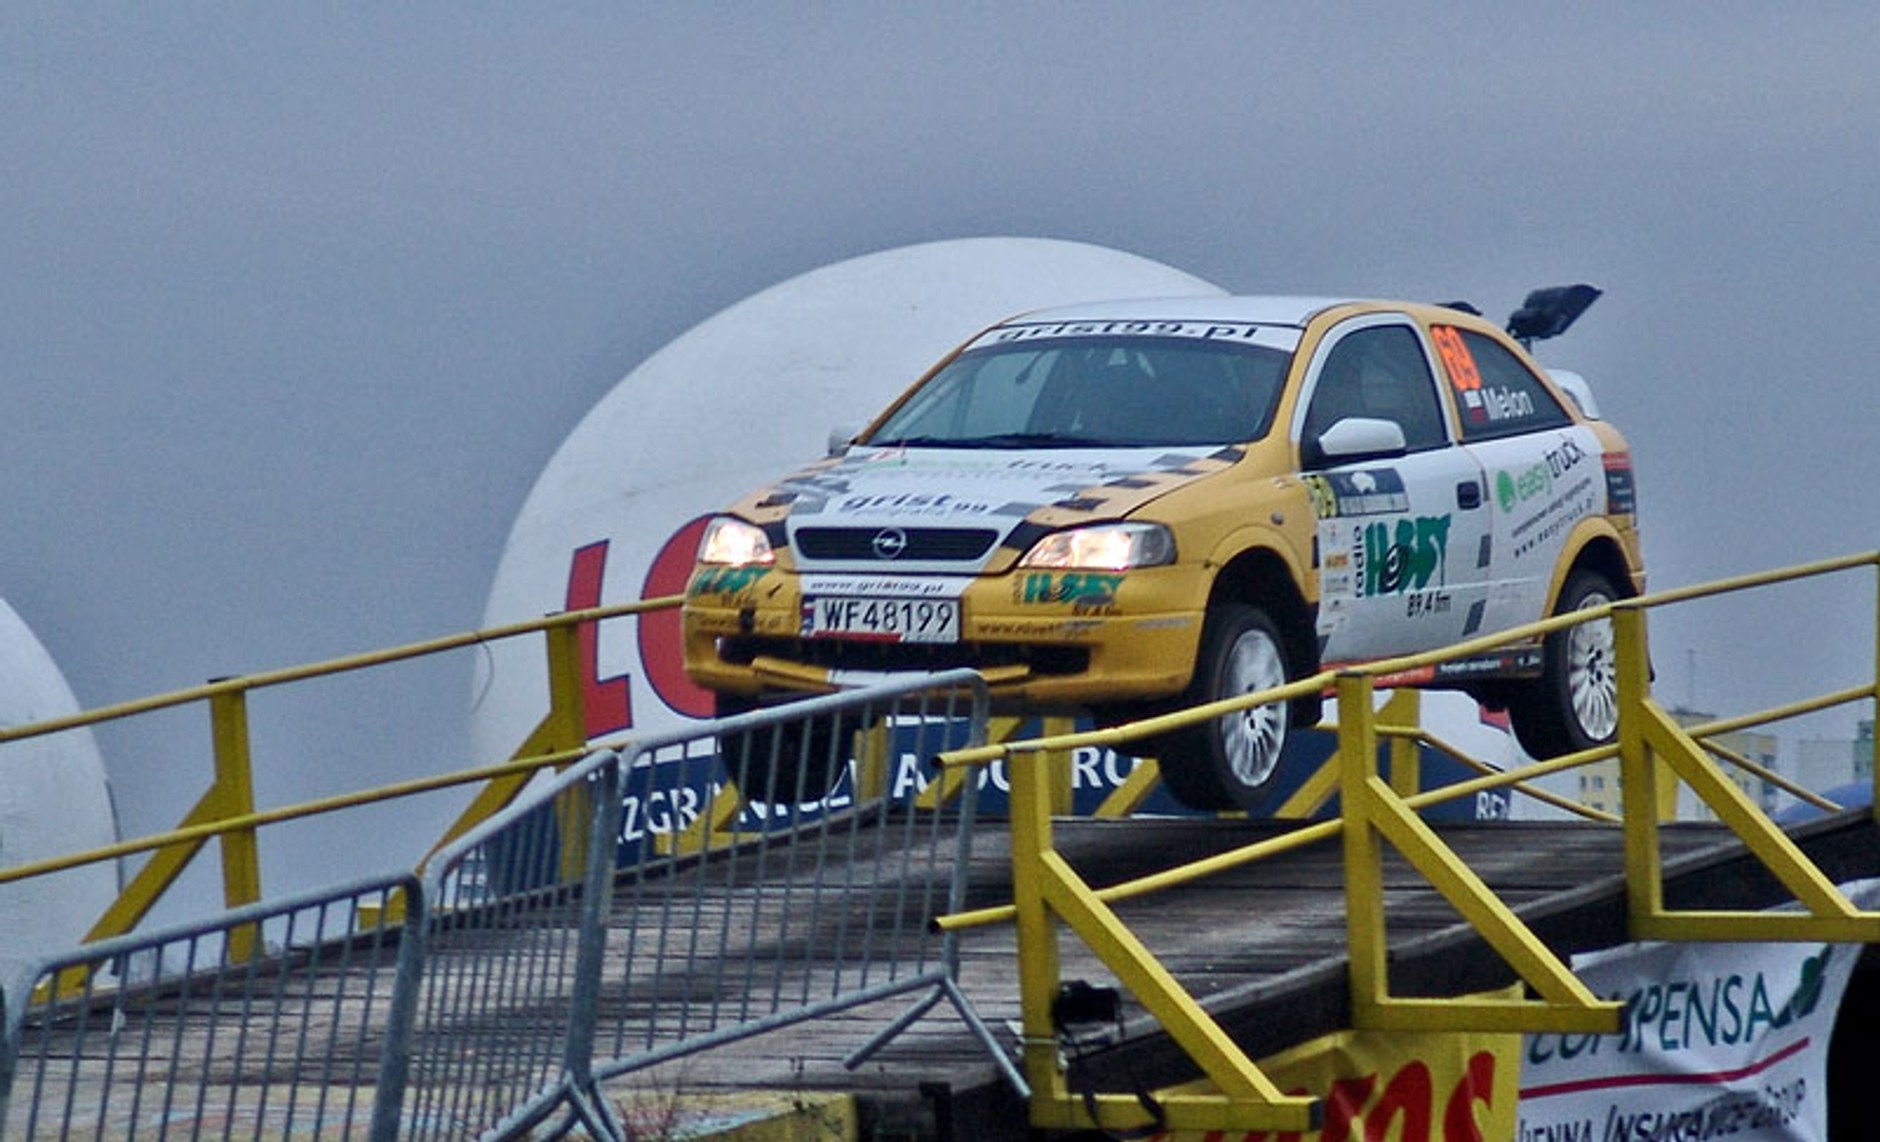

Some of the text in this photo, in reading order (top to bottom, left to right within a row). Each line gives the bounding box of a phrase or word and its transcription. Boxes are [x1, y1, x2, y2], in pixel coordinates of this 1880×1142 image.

[999, 321, 1259, 340] grist99.pl
[1481, 385, 1534, 420] Melon
[1353, 525, 1365, 598] radio
[823, 600, 953, 634] WF48199
